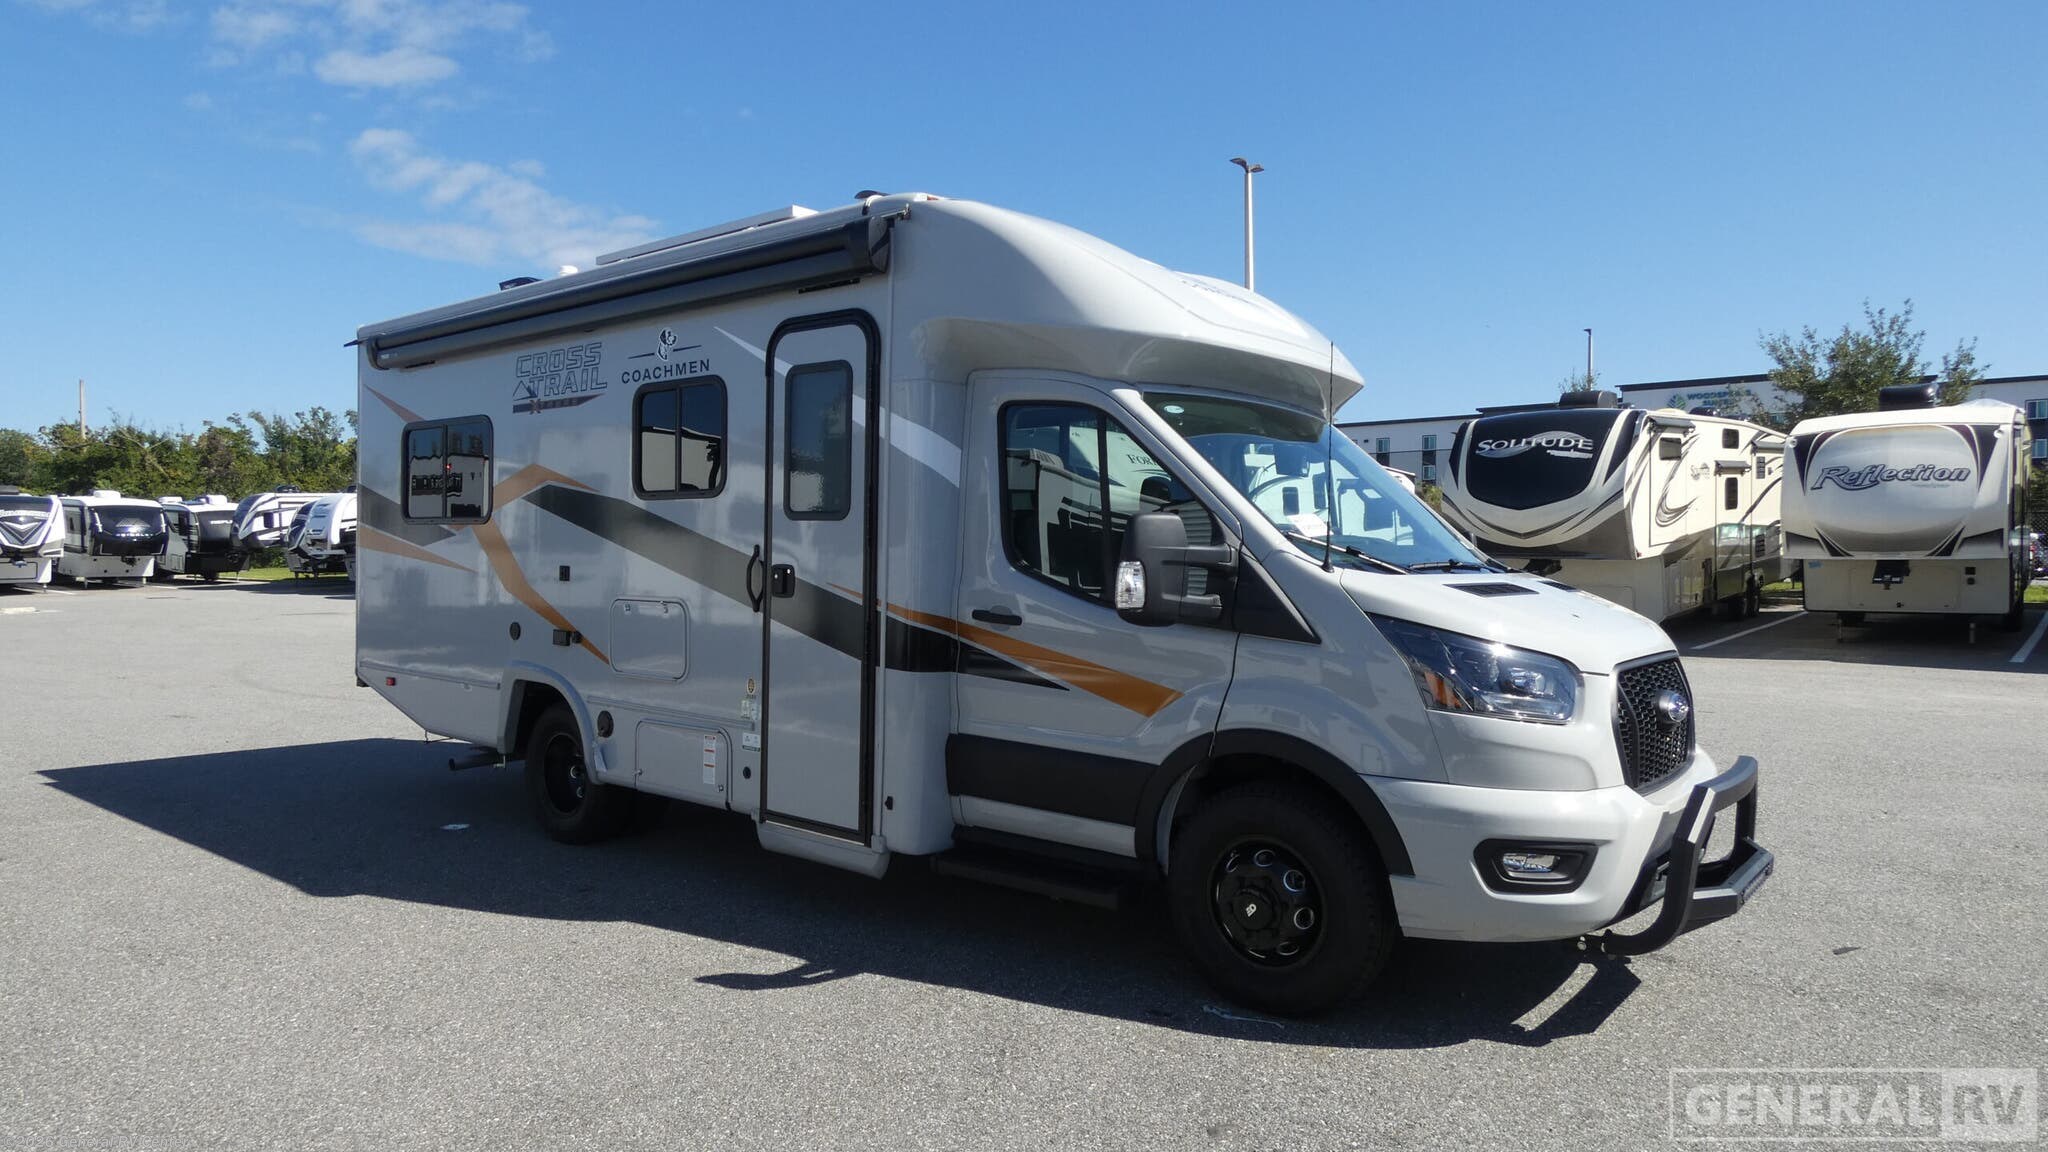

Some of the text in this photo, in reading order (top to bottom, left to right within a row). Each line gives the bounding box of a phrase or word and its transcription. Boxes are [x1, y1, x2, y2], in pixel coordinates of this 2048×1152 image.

[516, 342, 602, 378] CROSS
[621, 359, 710, 384] COACHMEN
[529, 367, 608, 398] TRAIL
[1477, 437, 1594, 452] SOLITUDE
[1126, 454, 1157, 466] FOR
[1811, 464, 1971, 491] Reflection
